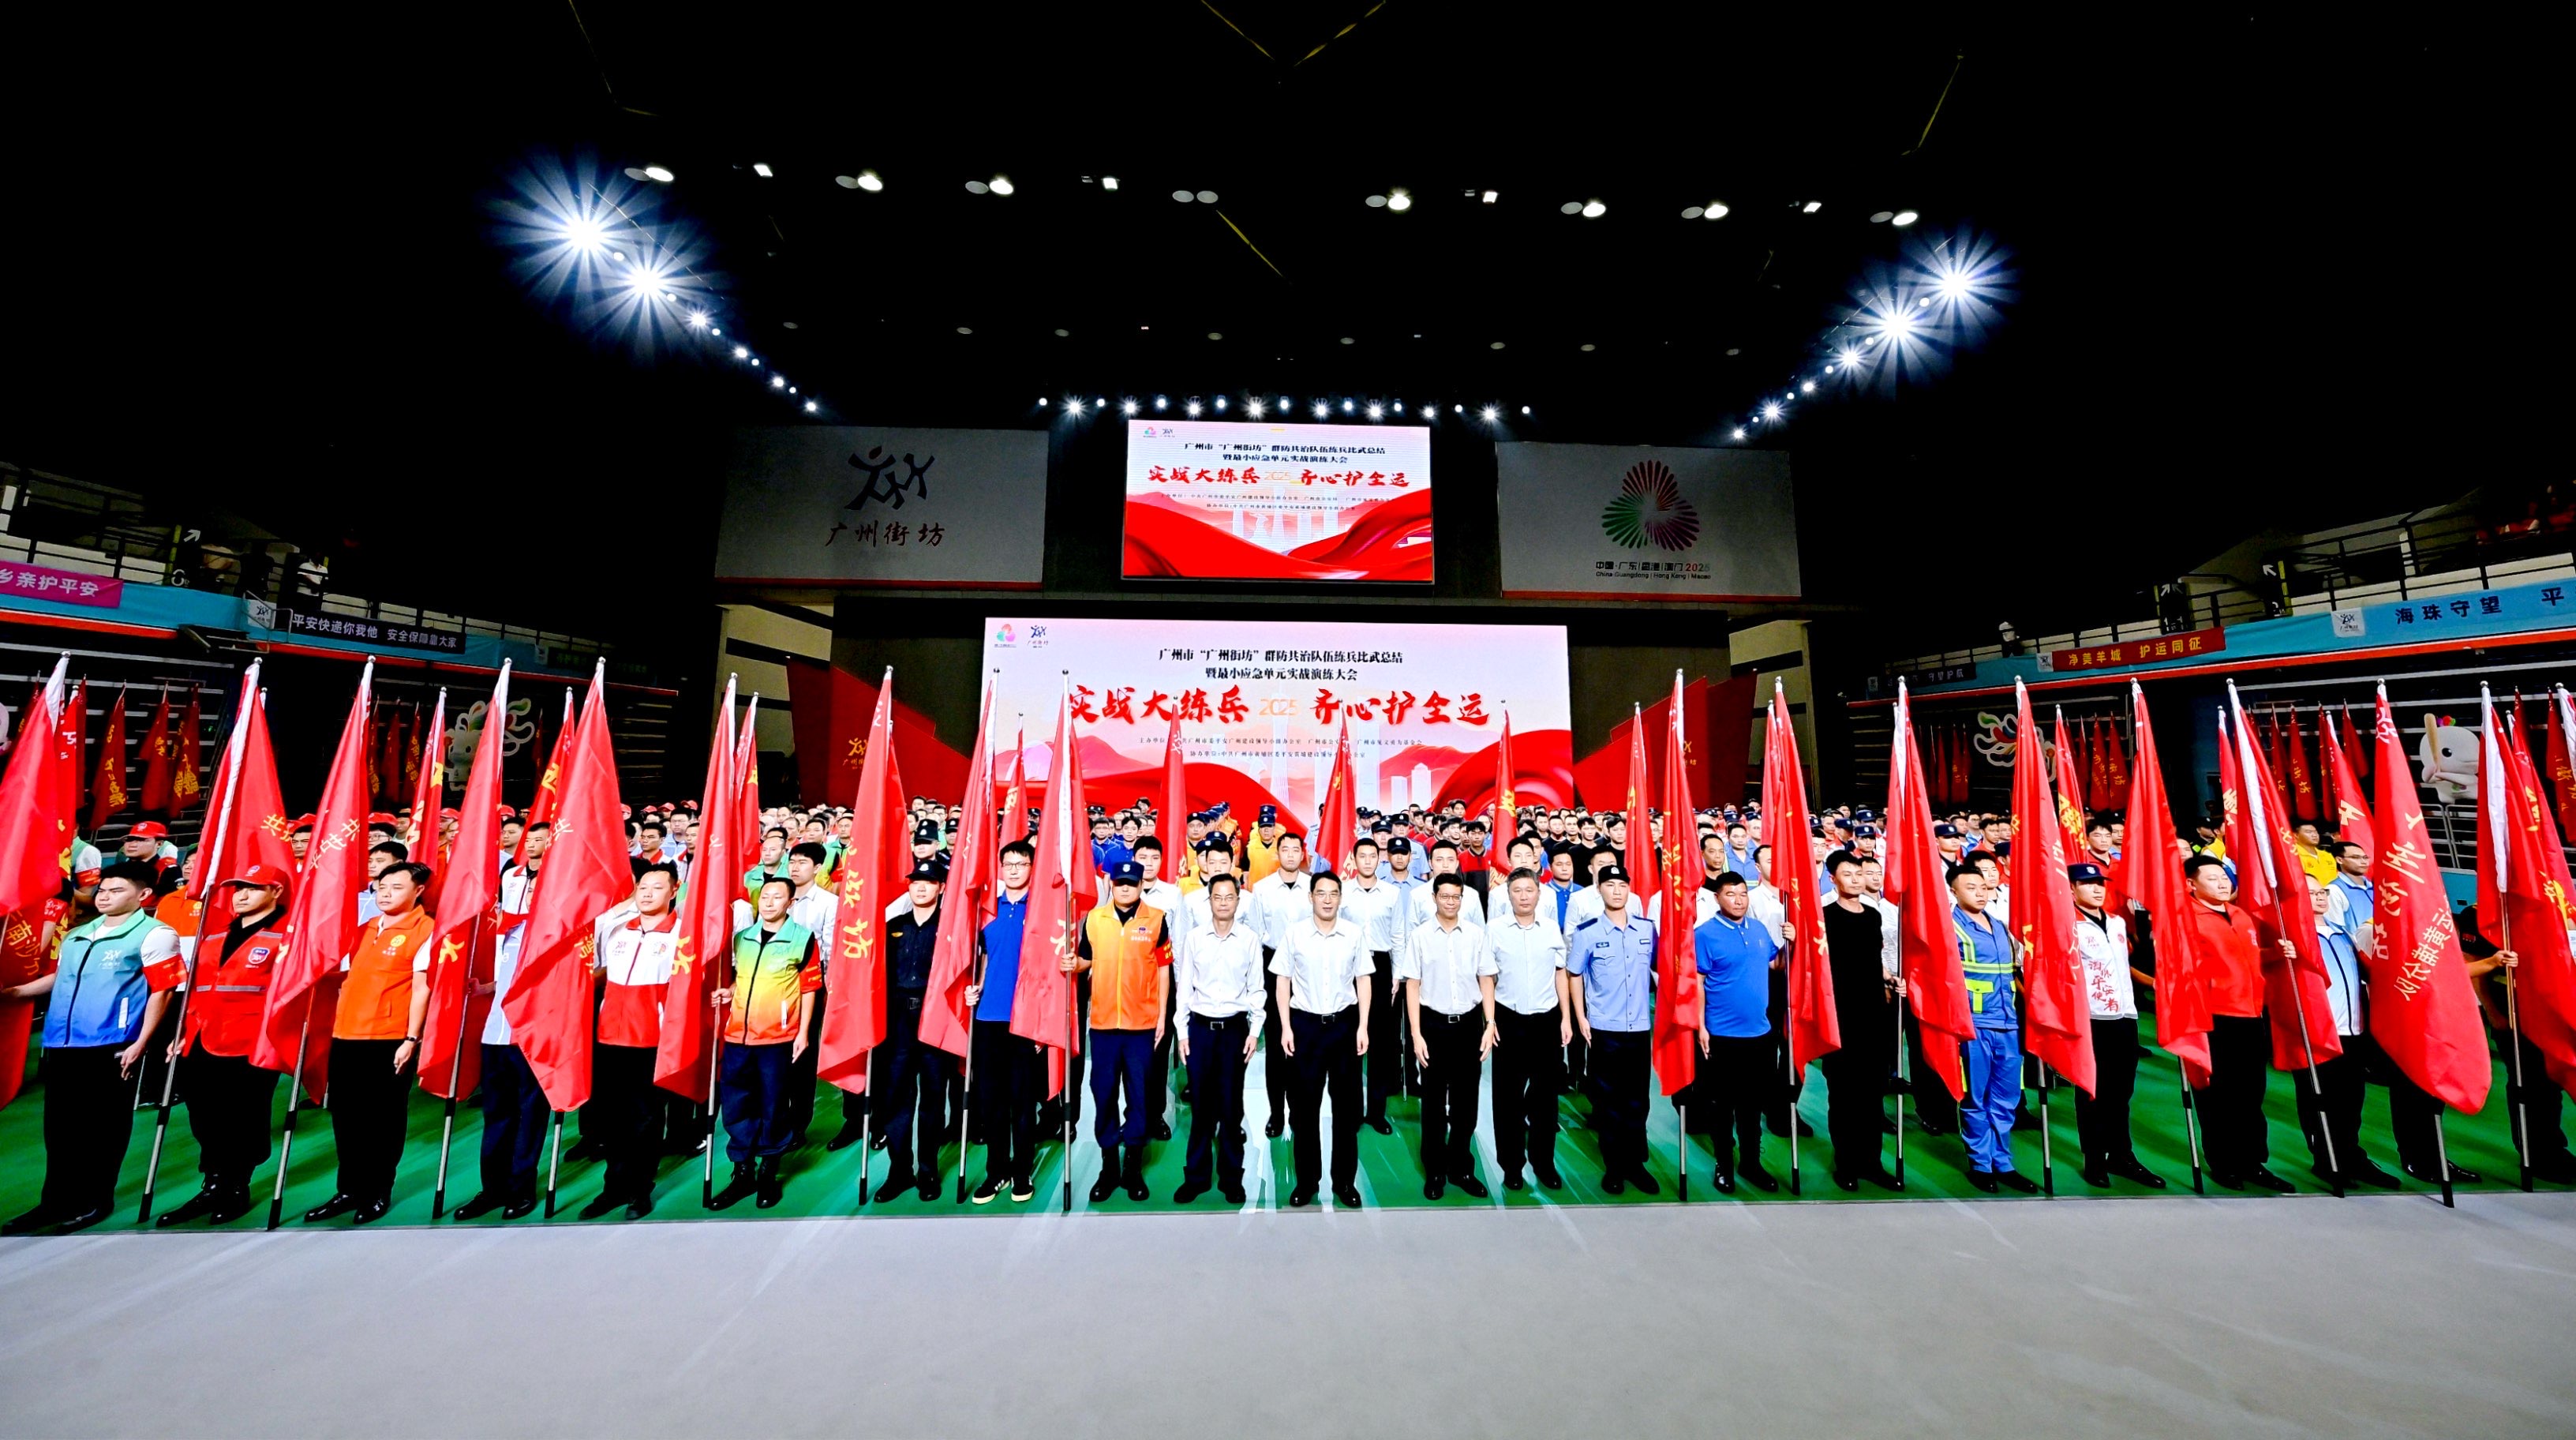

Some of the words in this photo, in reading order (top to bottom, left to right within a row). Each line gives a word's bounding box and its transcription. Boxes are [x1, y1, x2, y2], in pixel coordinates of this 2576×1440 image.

[1148, 465, 1260, 484] 实战大练兵
[1301, 469, 1410, 488] 齐心护全运
[825, 519, 945, 547] 广州街坊
[2394, 595, 2503, 624] 海珠守望
[293, 613, 378, 639] 平安快递你我他
[2068, 648, 2121, 666] 净美羊城
[2139, 636, 2203, 658] 护运同征
[1205, 667, 1358, 681] 暨最小应急单元实战演练大会
[1069, 684, 1249, 725] 实战大练兵
[1258, 698, 1301, 717] 2025
[1309, 688, 1490, 726] 齐心护全运
